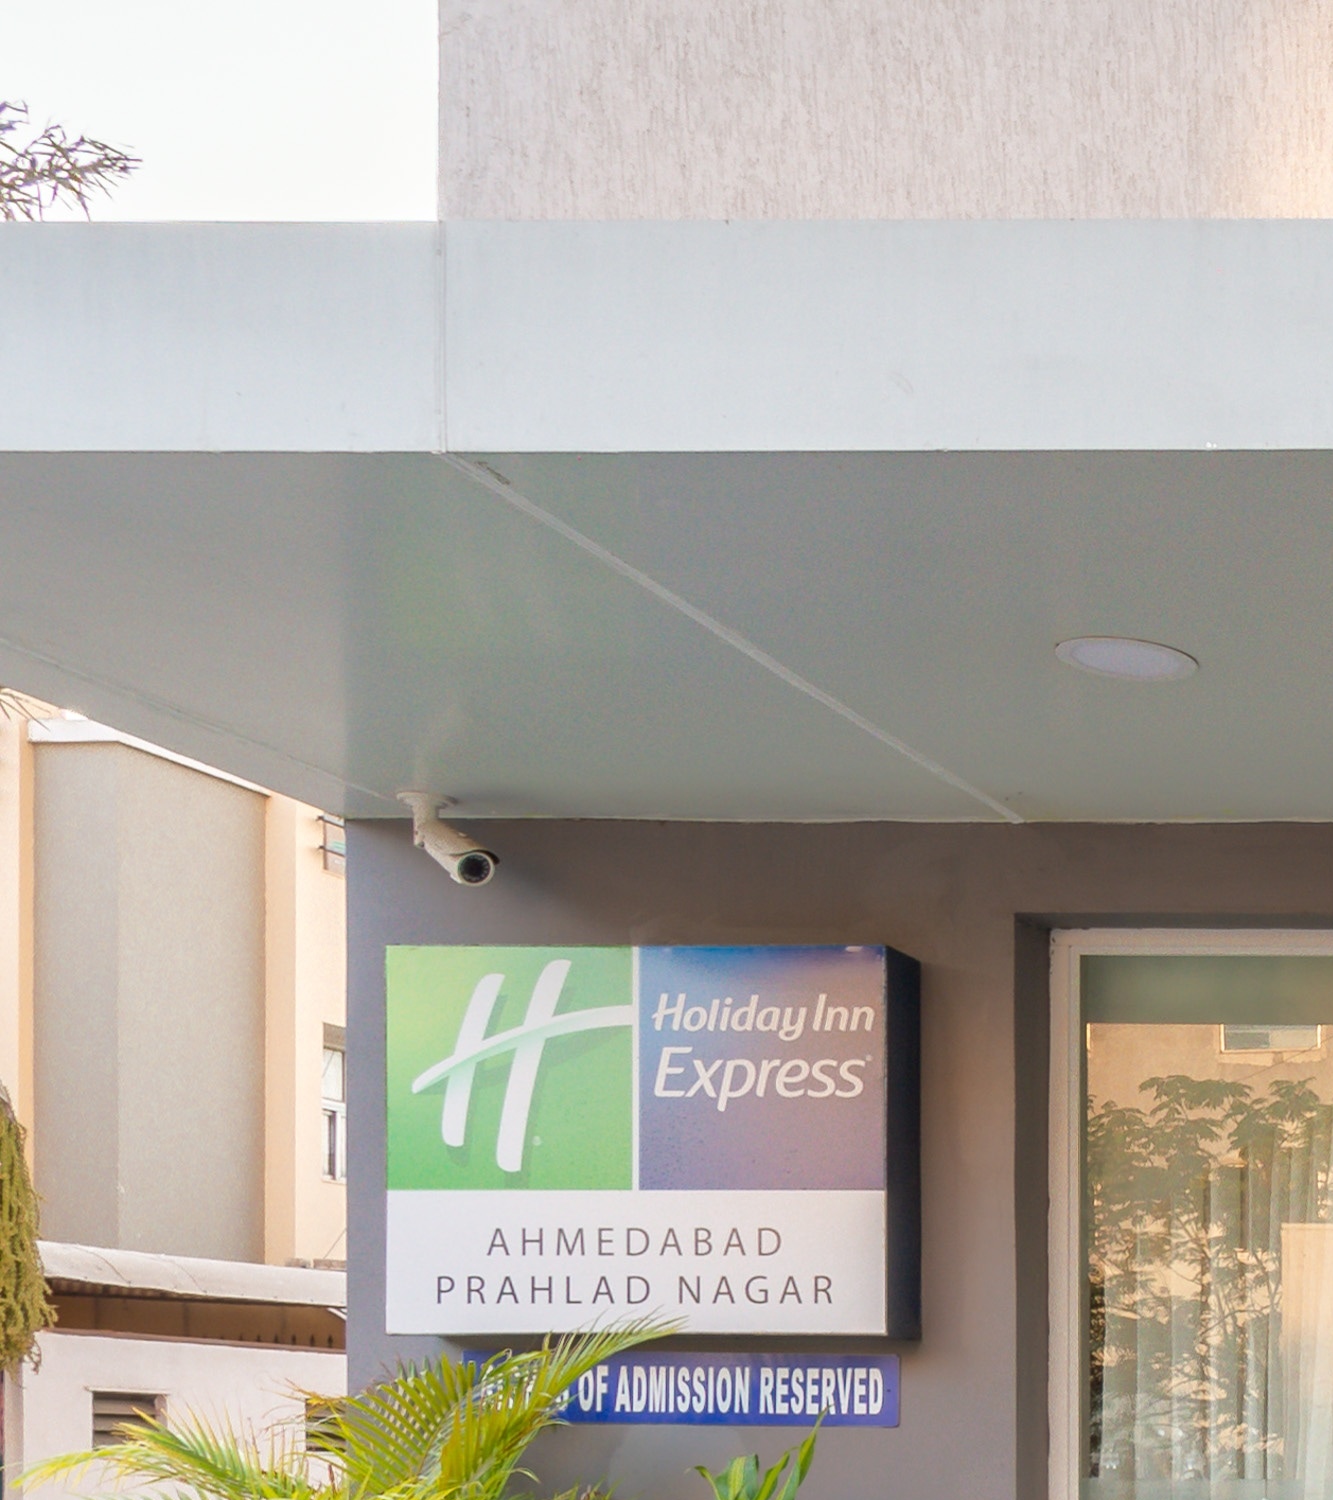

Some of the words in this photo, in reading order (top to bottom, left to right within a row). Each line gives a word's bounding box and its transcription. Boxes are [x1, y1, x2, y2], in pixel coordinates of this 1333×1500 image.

[652, 993, 808, 1041] Holiday
[812, 994, 875, 1032] Inn
[653, 1046, 867, 1112] Express
[487, 1228, 782, 1257] AHMEDABAD
[436, 1276, 652, 1304] PRAHLAD
[678, 1276, 835, 1304] NAGAR
[578, 1365, 609, 1413] OF
[614, 1365, 750, 1414] ADMISSION
[758, 1367, 884, 1415] RESERVED
